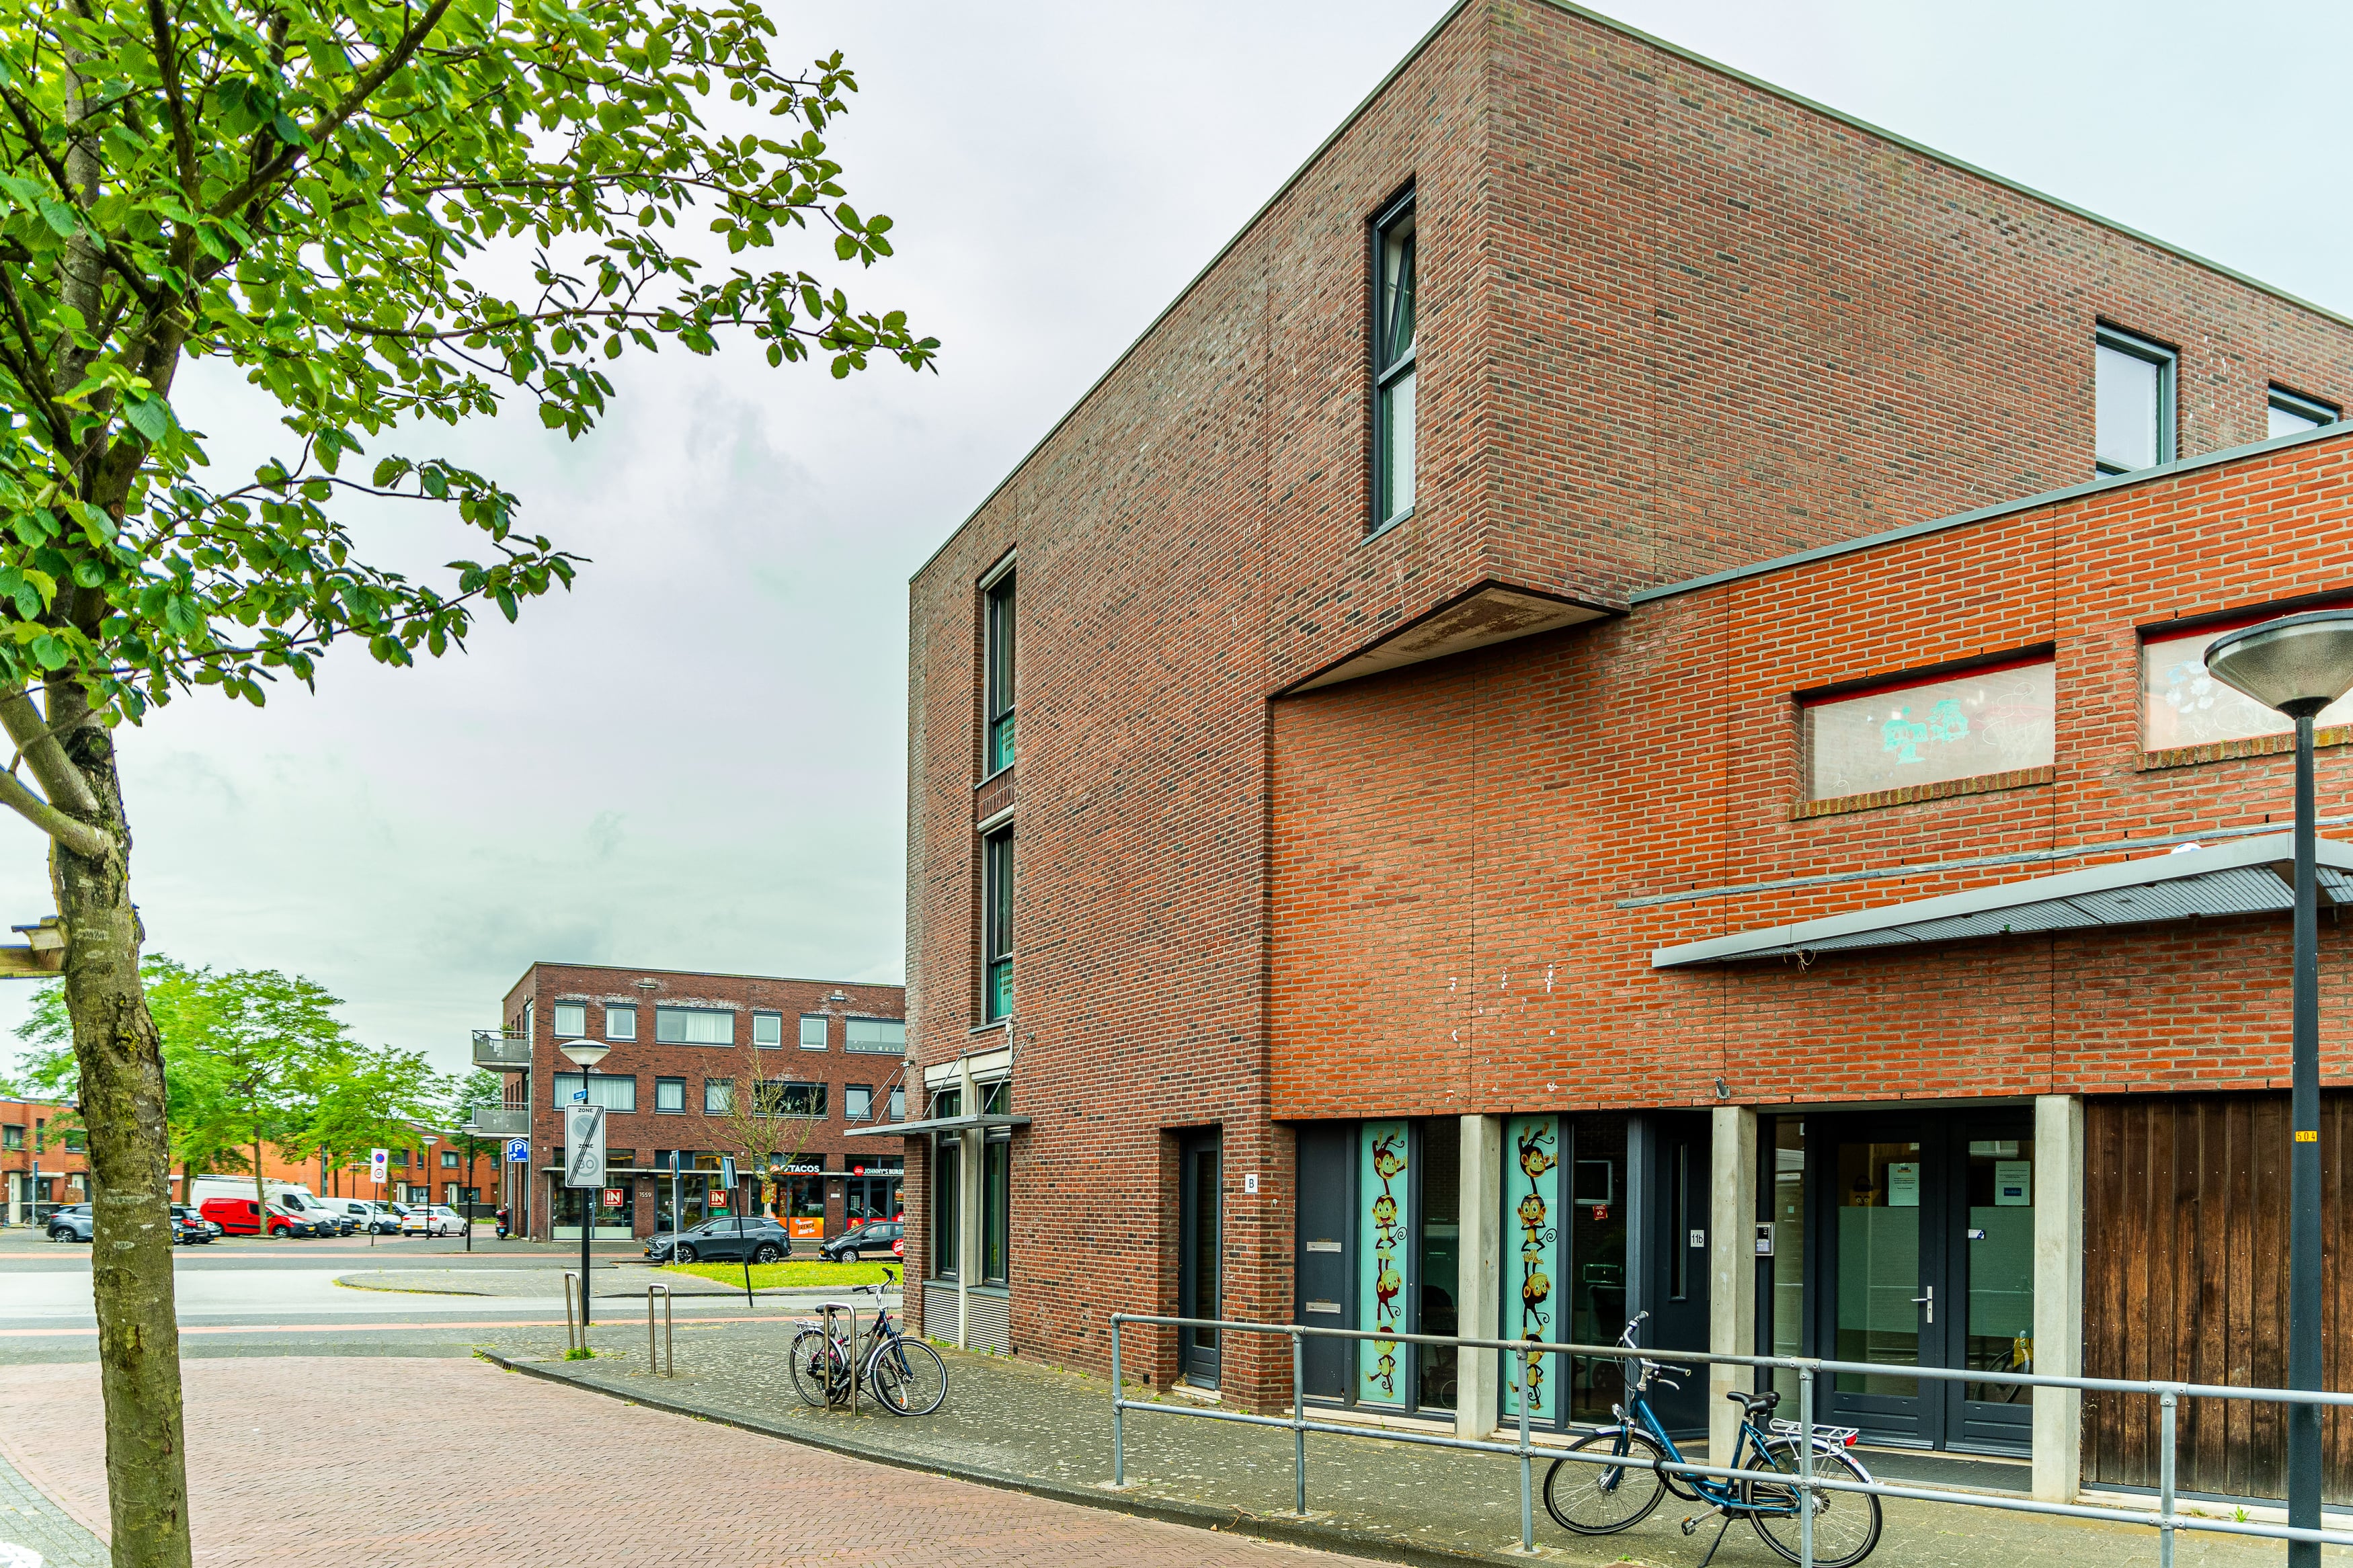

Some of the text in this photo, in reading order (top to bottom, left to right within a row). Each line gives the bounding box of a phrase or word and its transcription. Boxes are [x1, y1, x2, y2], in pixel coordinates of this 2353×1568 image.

[2297, 1132, 2315, 1141] 504
[515, 1144, 522, 1152] P
[1249, 1178, 1254, 1188] B
[1691, 1234, 1703, 1243] 11b
